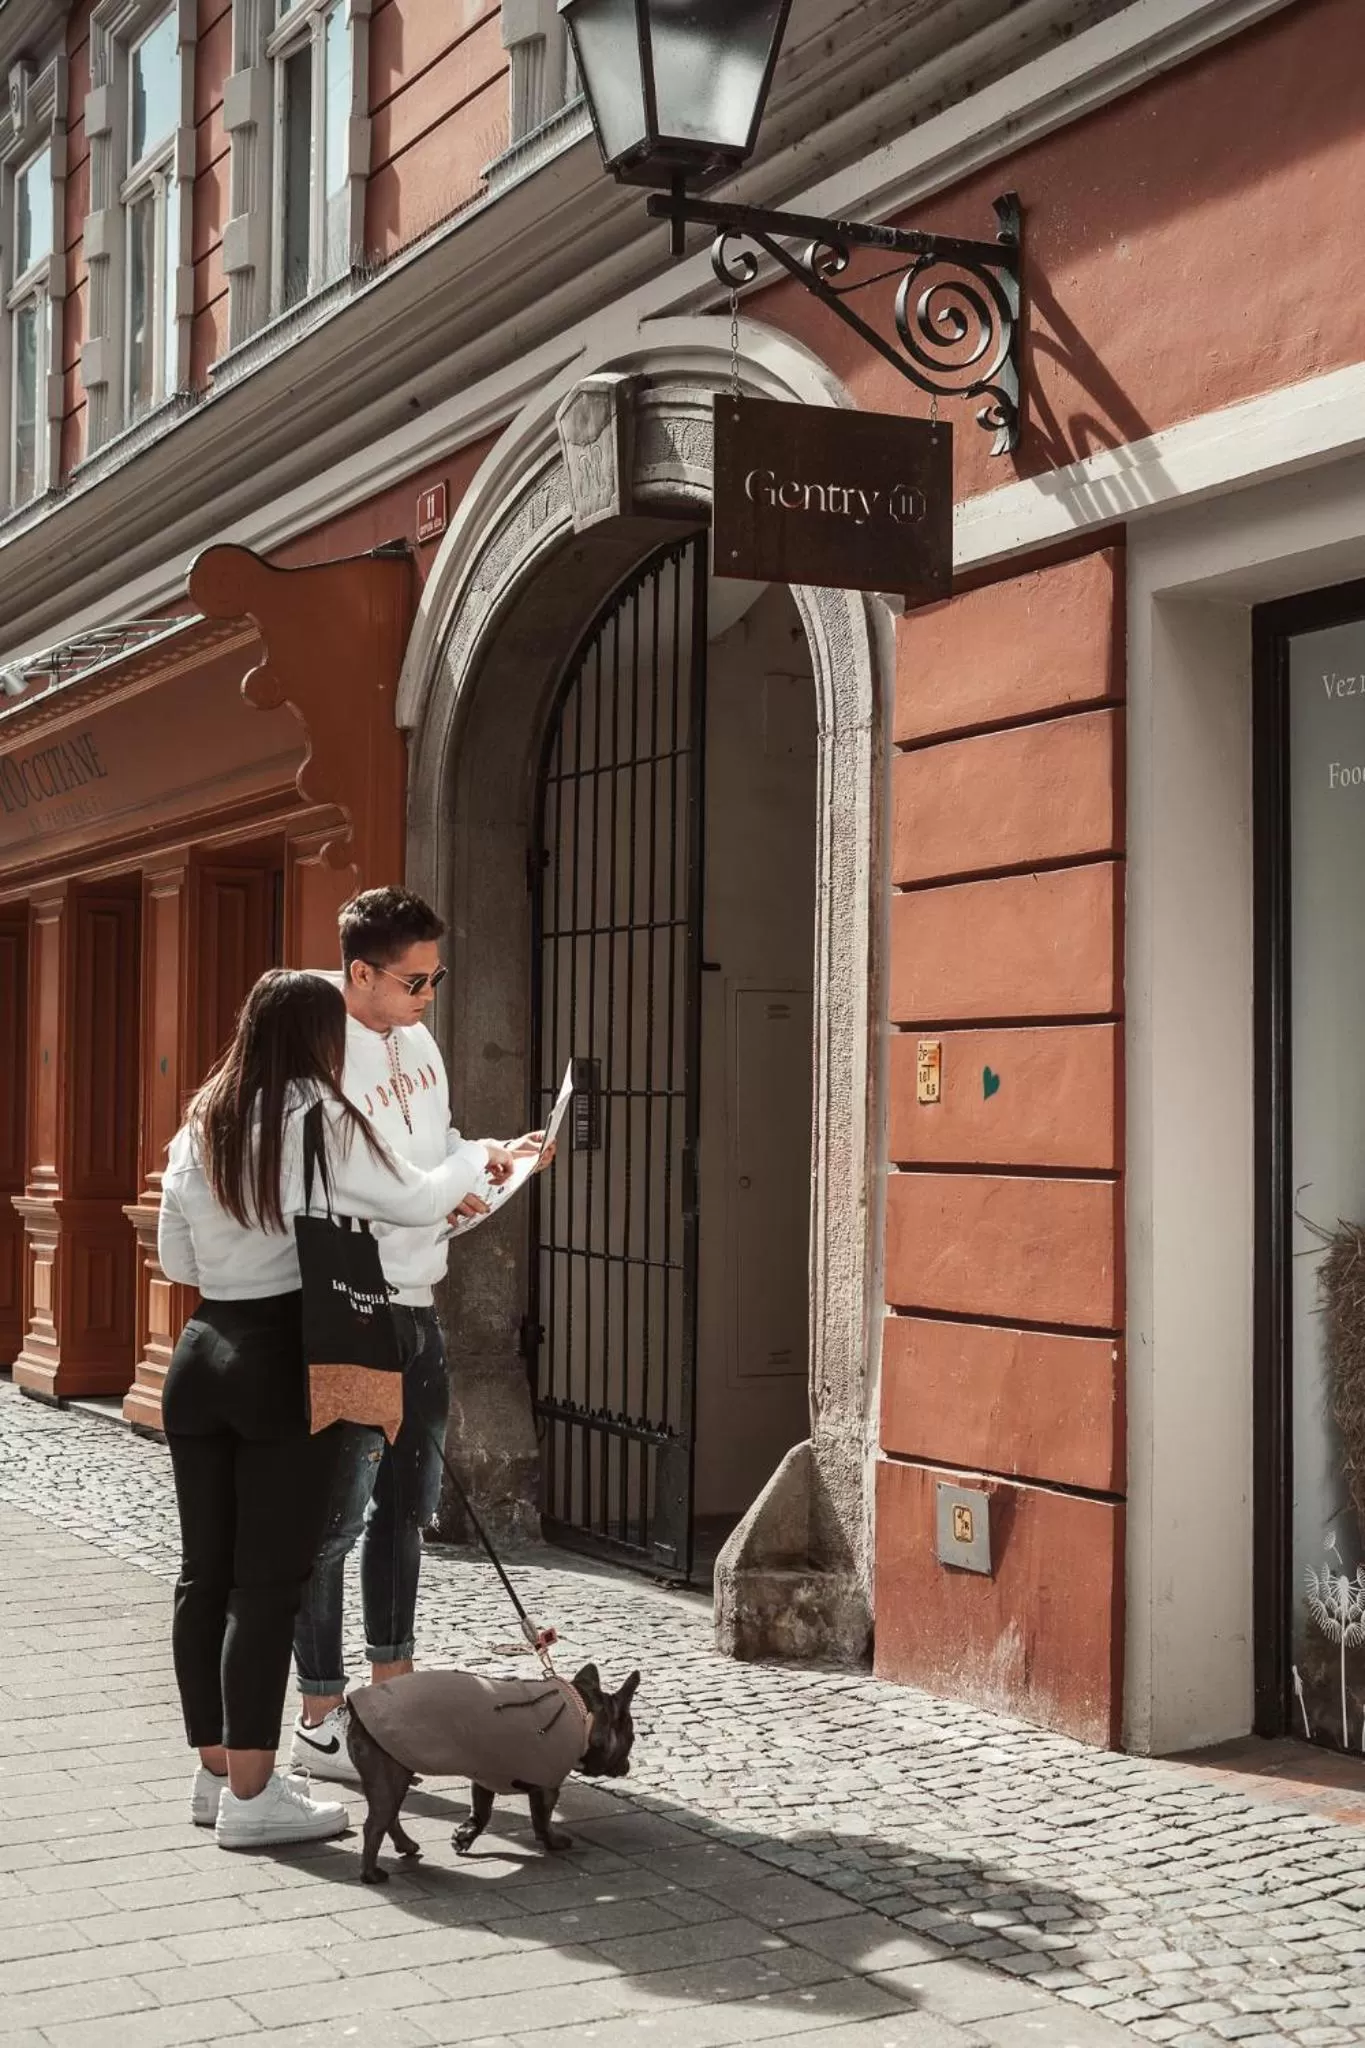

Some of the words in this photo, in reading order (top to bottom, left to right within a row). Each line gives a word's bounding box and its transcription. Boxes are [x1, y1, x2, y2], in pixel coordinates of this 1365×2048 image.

[426, 493, 435, 519] 11
[745, 468, 880, 524] Gentry
[1329, 762, 1365, 789] Foo
